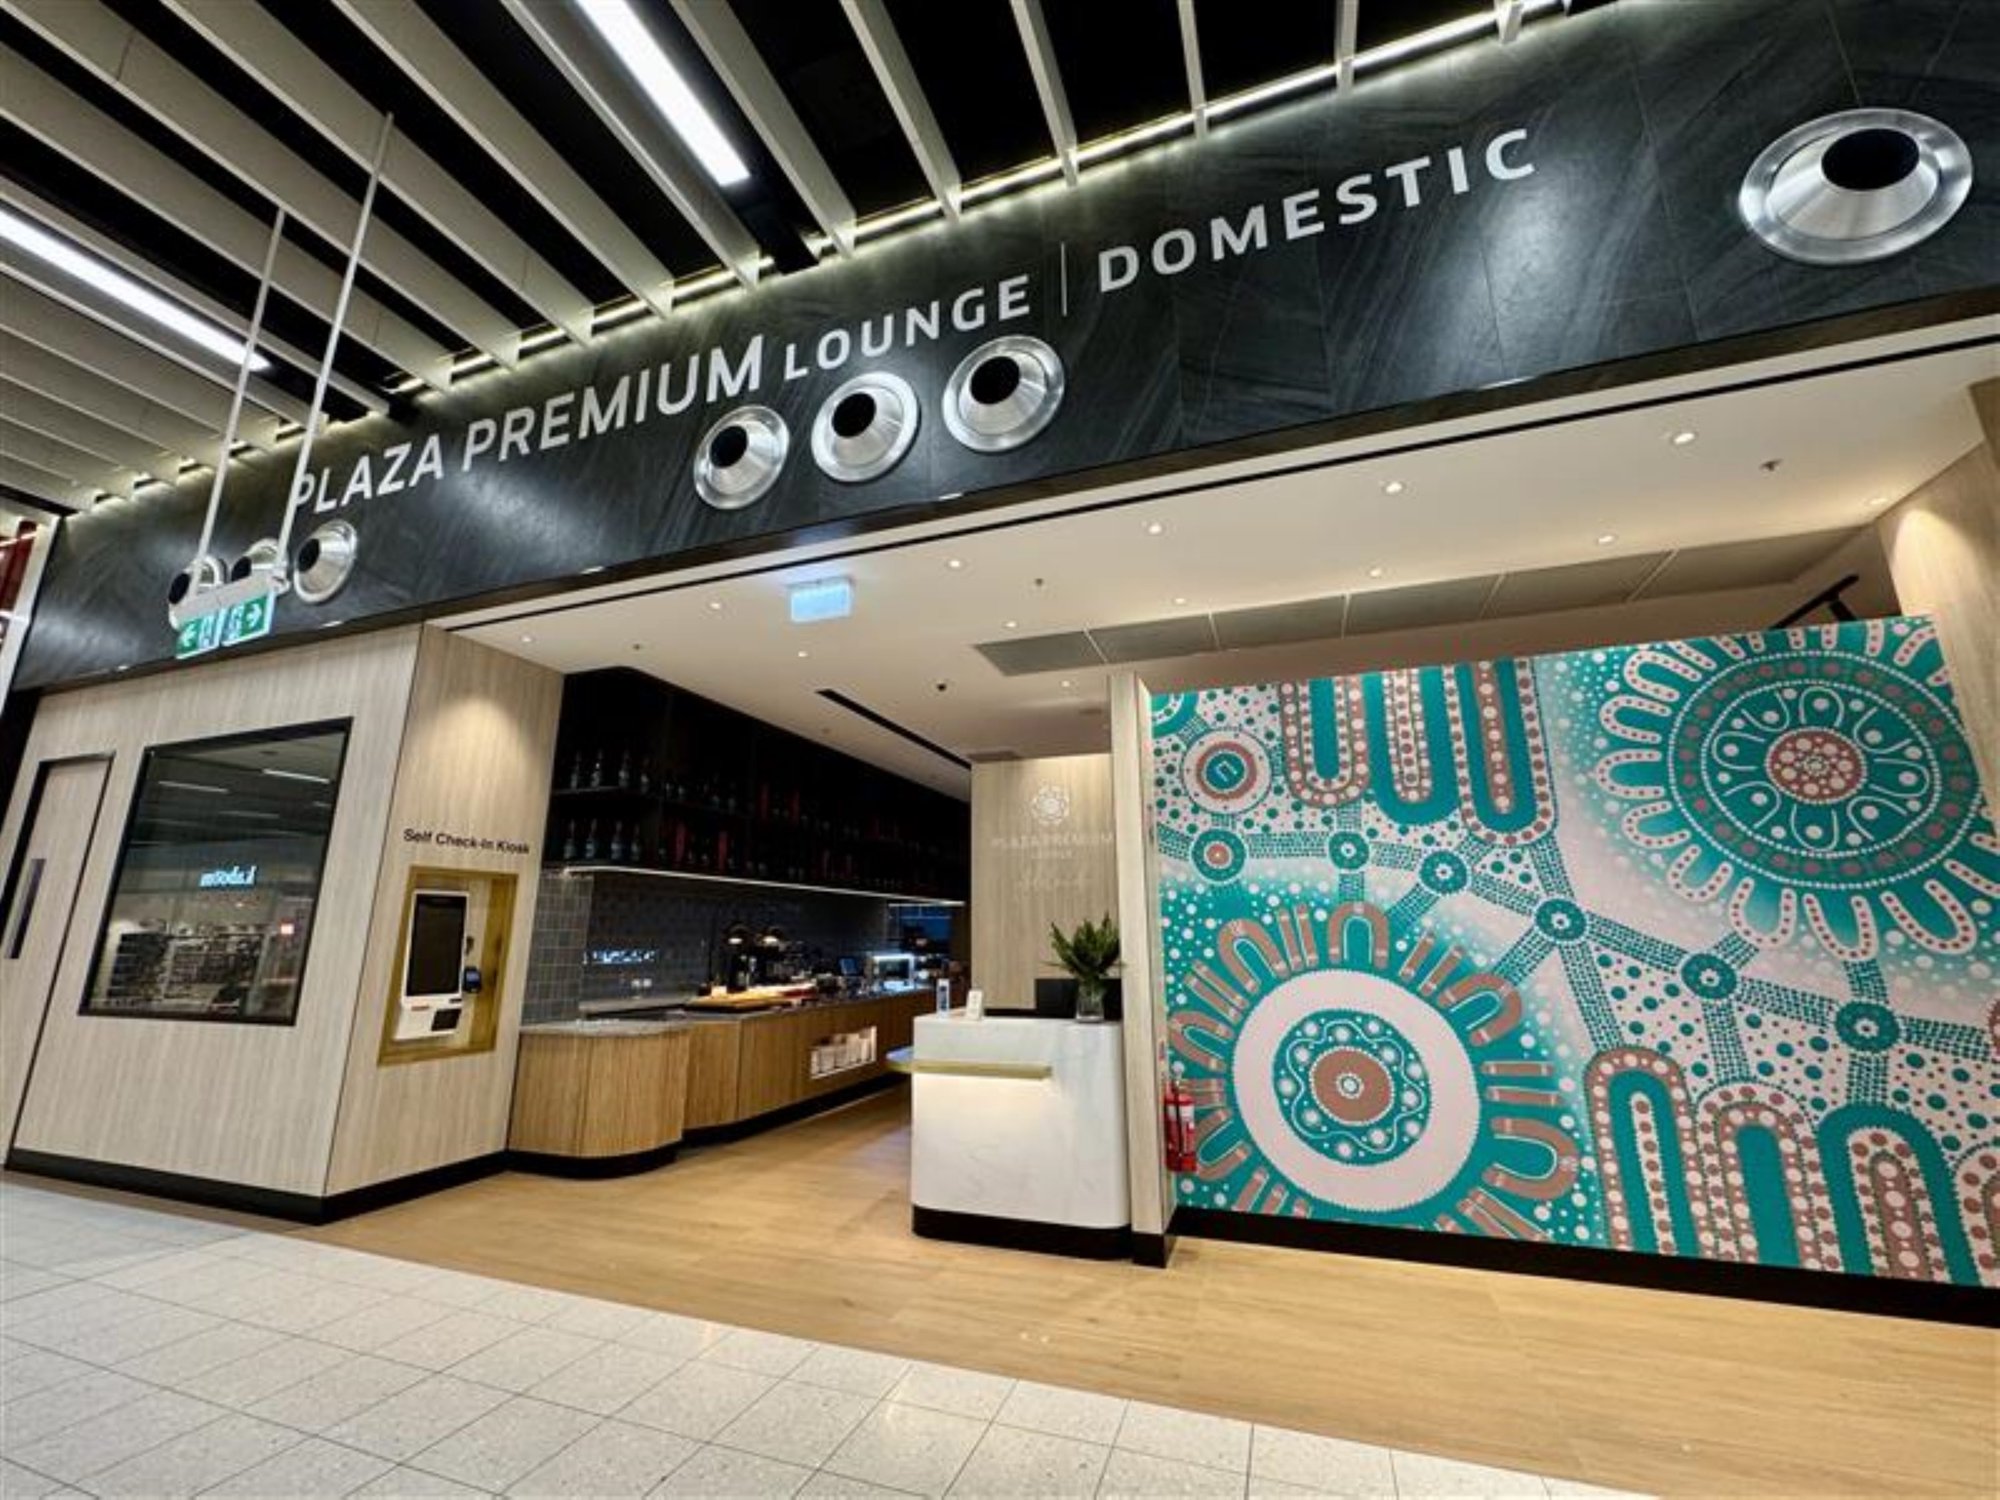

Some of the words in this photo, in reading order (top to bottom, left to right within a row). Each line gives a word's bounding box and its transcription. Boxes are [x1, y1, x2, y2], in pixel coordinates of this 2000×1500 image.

[289, 432, 444, 514] PLAZA
[461, 334, 764, 472] PREMIUM
[783, 274, 1031, 380] LOUNGE
[1098, 128, 1538, 294] DOMESTIC
[403, 828, 432, 842] Self
[496, 840, 530, 854] Kiosk
